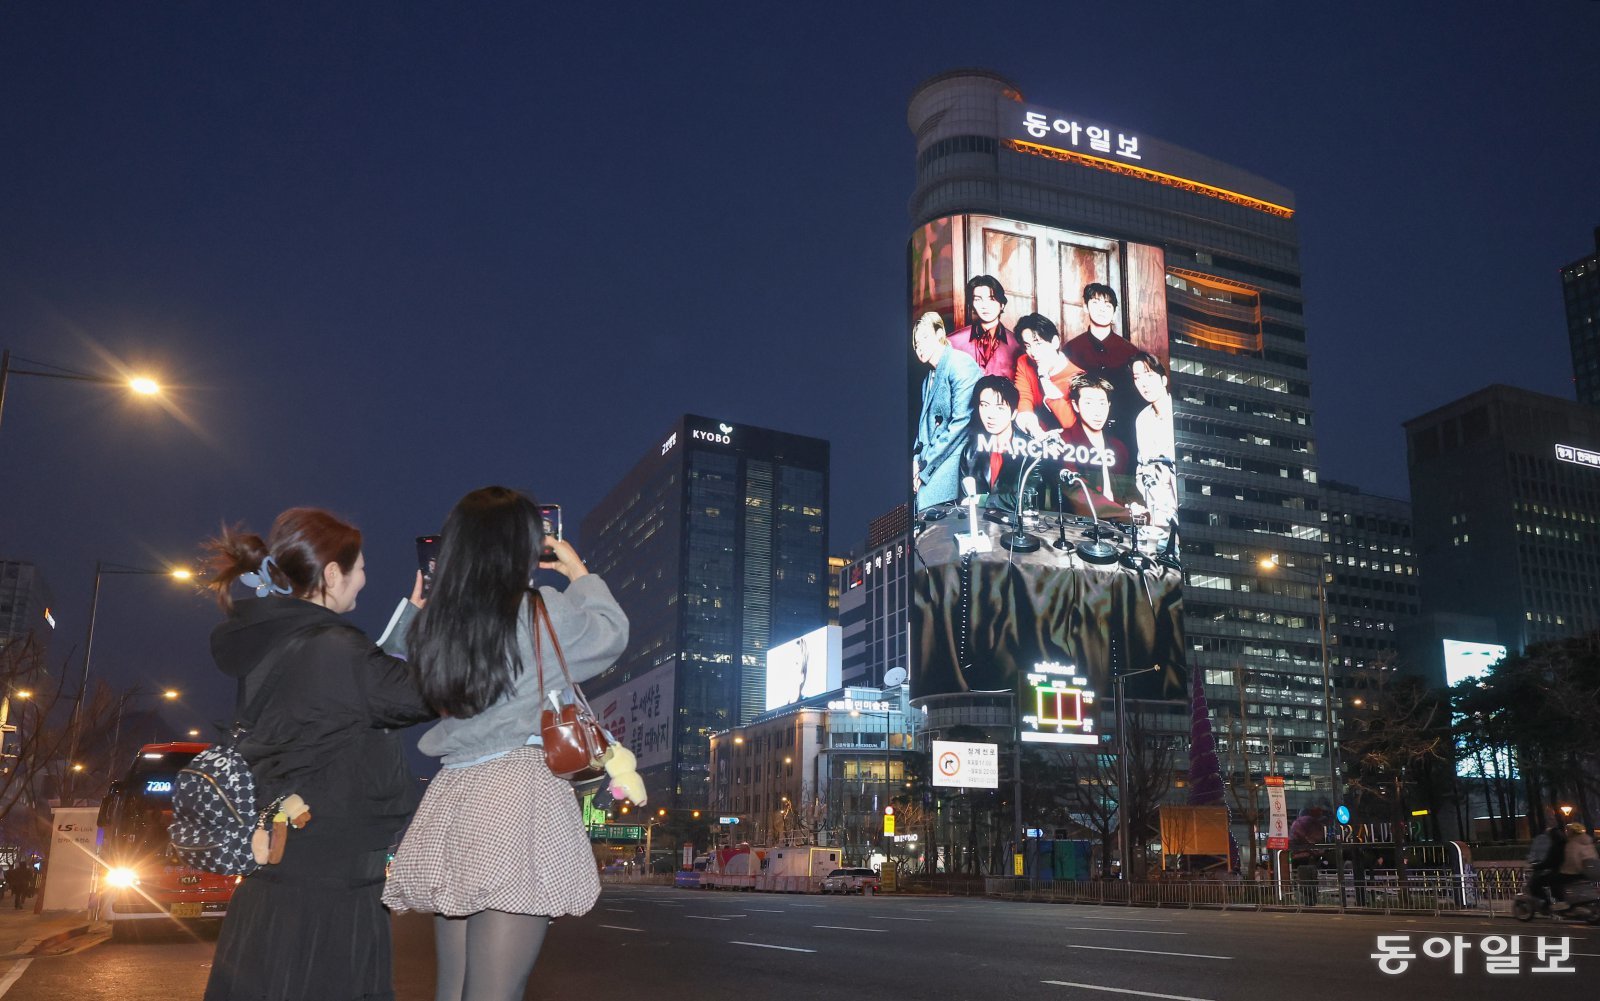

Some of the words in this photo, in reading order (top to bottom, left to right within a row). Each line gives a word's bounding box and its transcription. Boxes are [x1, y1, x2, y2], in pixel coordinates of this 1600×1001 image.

[1022, 110, 1142, 161] 동아일보
[692, 429, 731, 445] KYOBO
[976, 433, 1060, 461] MARCH
[1063, 443, 1117, 468] 2026
[968, 747, 996, 756] 청계천로
[146, 781, 171, 792] 7200
[57, 824, 73, 832] LS
[181, 875, 198, 884] KIA
